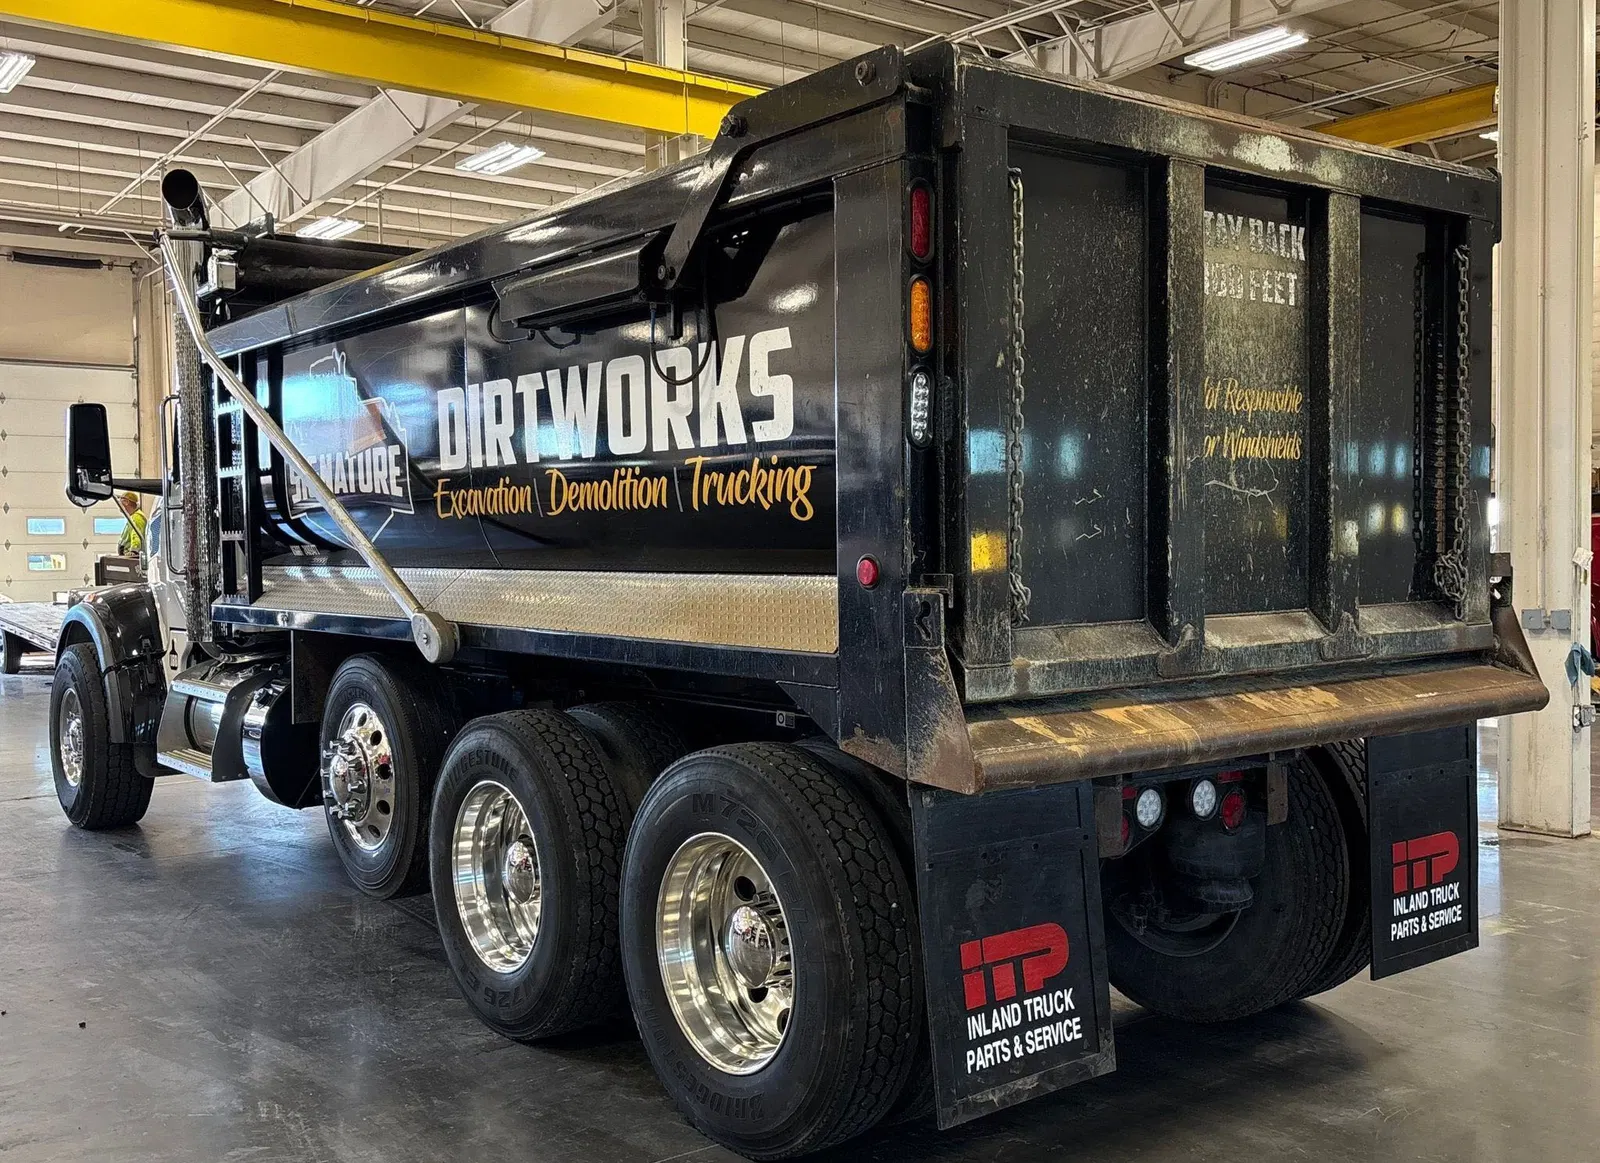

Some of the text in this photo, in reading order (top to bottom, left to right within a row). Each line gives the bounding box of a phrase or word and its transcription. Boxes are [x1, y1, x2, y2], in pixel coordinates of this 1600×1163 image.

[1203, 211, 1306, 261] TAY BACK
[1249, 267, 1298, 306] FEET
[437, 326, 795, 471] DIRTWORKS
[1223, 377, 1303, 423] Responsible
[1203, 425, 1302, 461] or Windshields
[289, 444, 404, 504] SINATURE
[433, 455, 818, 522] Excavation Demolition Trucking
[1390, 904, 1463, 942] PARTS & SERVICE
[1393, 882, 1460, 917] INLAND TRUCK
[966, 987, 1076, 1041] INLAND TRUCK
[966, 1016, 1083, 1075] PARTS & SERVICE
